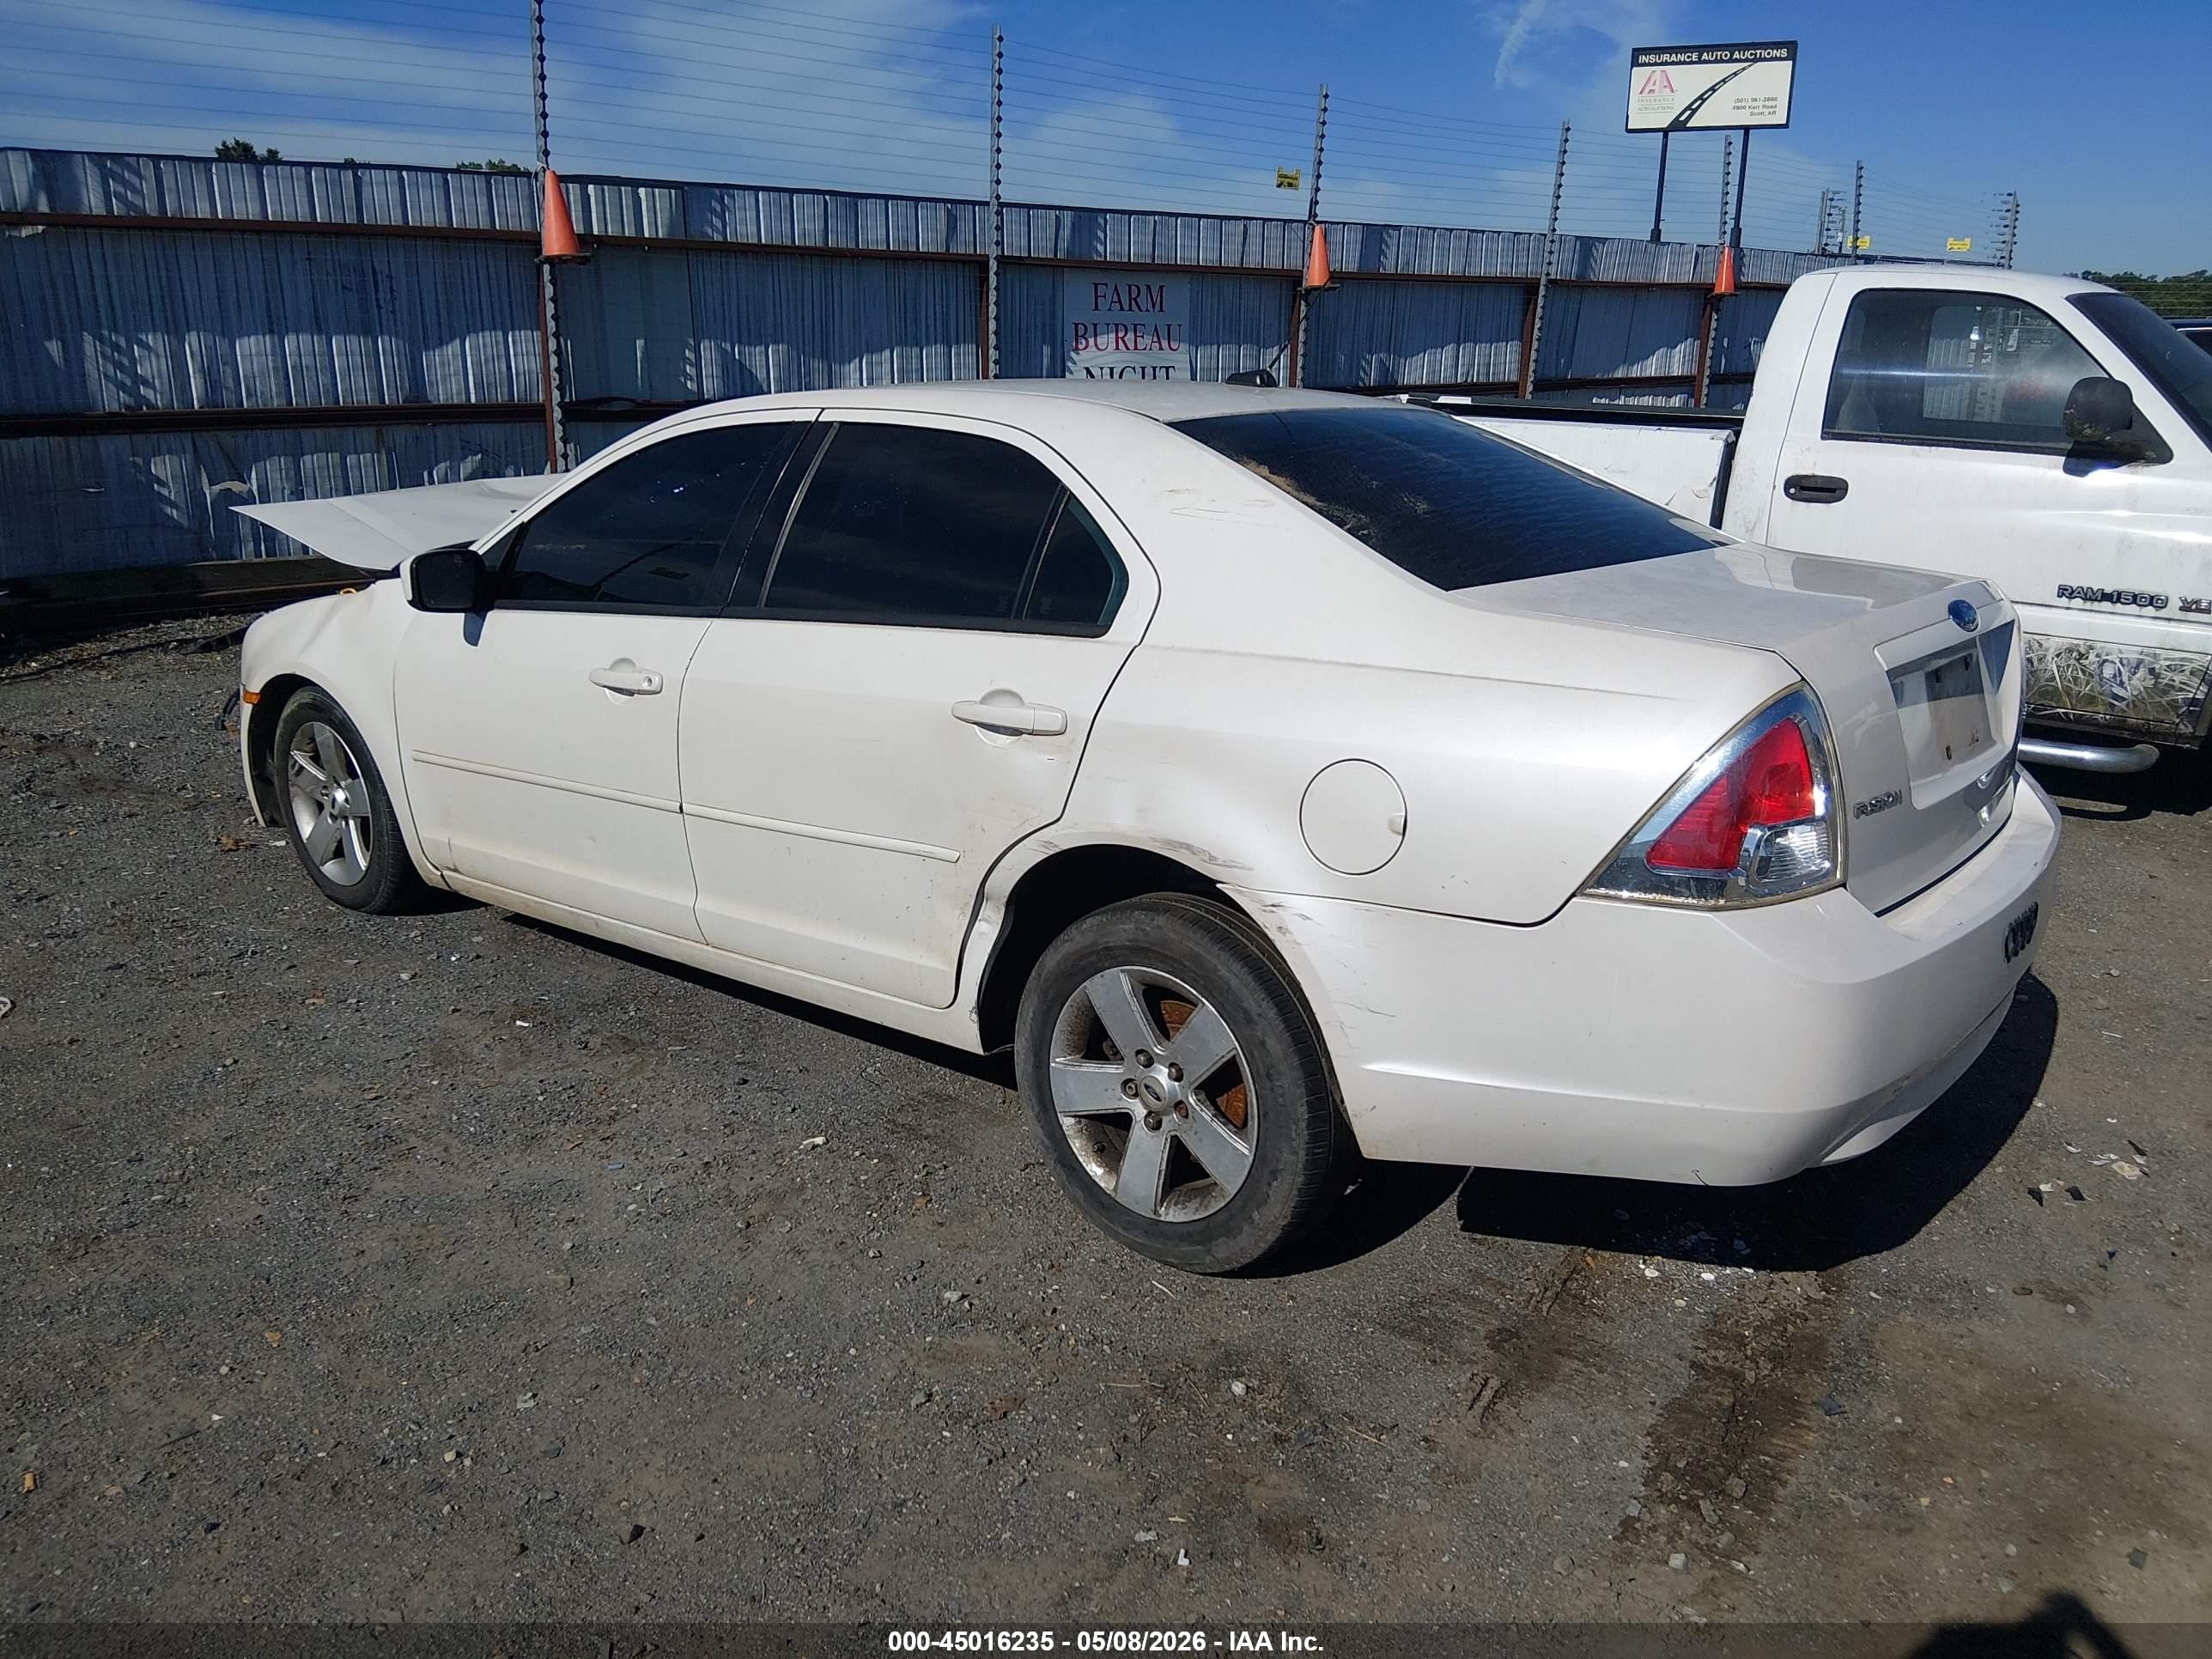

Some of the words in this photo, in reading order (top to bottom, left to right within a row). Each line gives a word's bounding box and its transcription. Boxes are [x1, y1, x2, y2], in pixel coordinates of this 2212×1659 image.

[1638, 52, 1698, 64] INSURANCE
[1701, 51, 1730, 61] AUTO
[1732, 48, 1788, 59] AUCTIONS
[1091, 283, 1167, 313] FARM
[1072, 322, 1182, 351] BUREAU
[2057, 585, 2105, 603] RAM
[2108, 590, 2169, 609] 1500
[1853, 789, 1903, 819] FUSION
